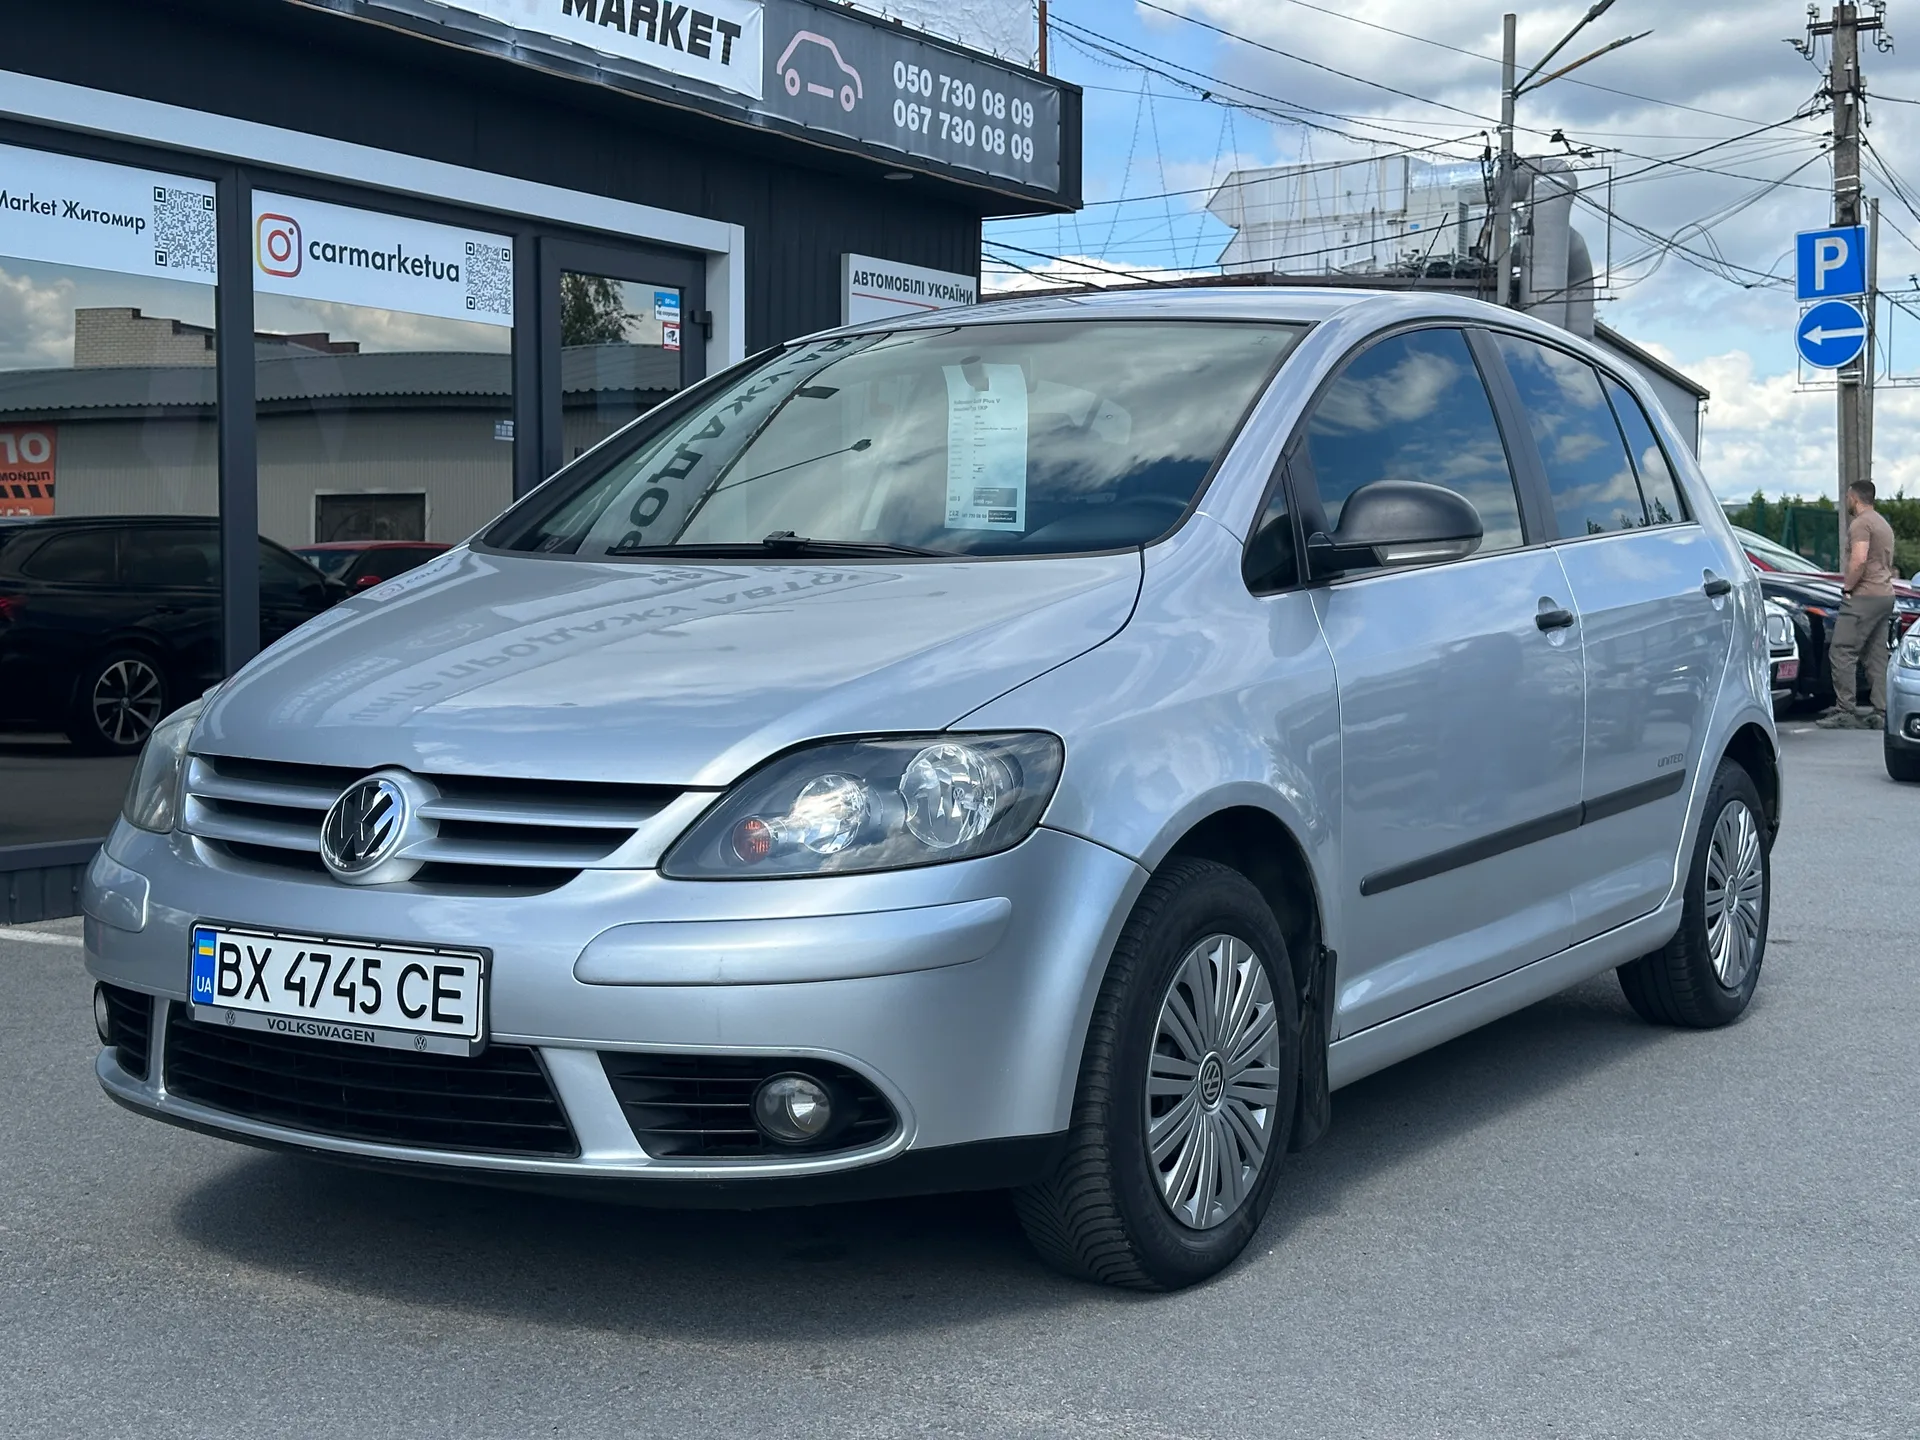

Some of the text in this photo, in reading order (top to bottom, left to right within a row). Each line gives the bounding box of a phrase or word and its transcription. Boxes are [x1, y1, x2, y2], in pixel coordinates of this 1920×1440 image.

[893, 60, 1034, 128] 050 730 08 09
[893, 99, 1034, 163] 067 730 08 09
[62, 199, 146, 234] Житомир
[309, 240, 460, 282] carmarketua
[1815, 236, 1849, 291] P
[853, 270, 974, 305] АВТОМОБІЛІ УКРАЇНИ
[1657, 753, 1684, 768] UNITED
[196, 976, 212, 994] UA
[217, 942, 465, 1024] BX 4745 CE
[267, 1018, 375, 1043] VOLKSWAGEN
